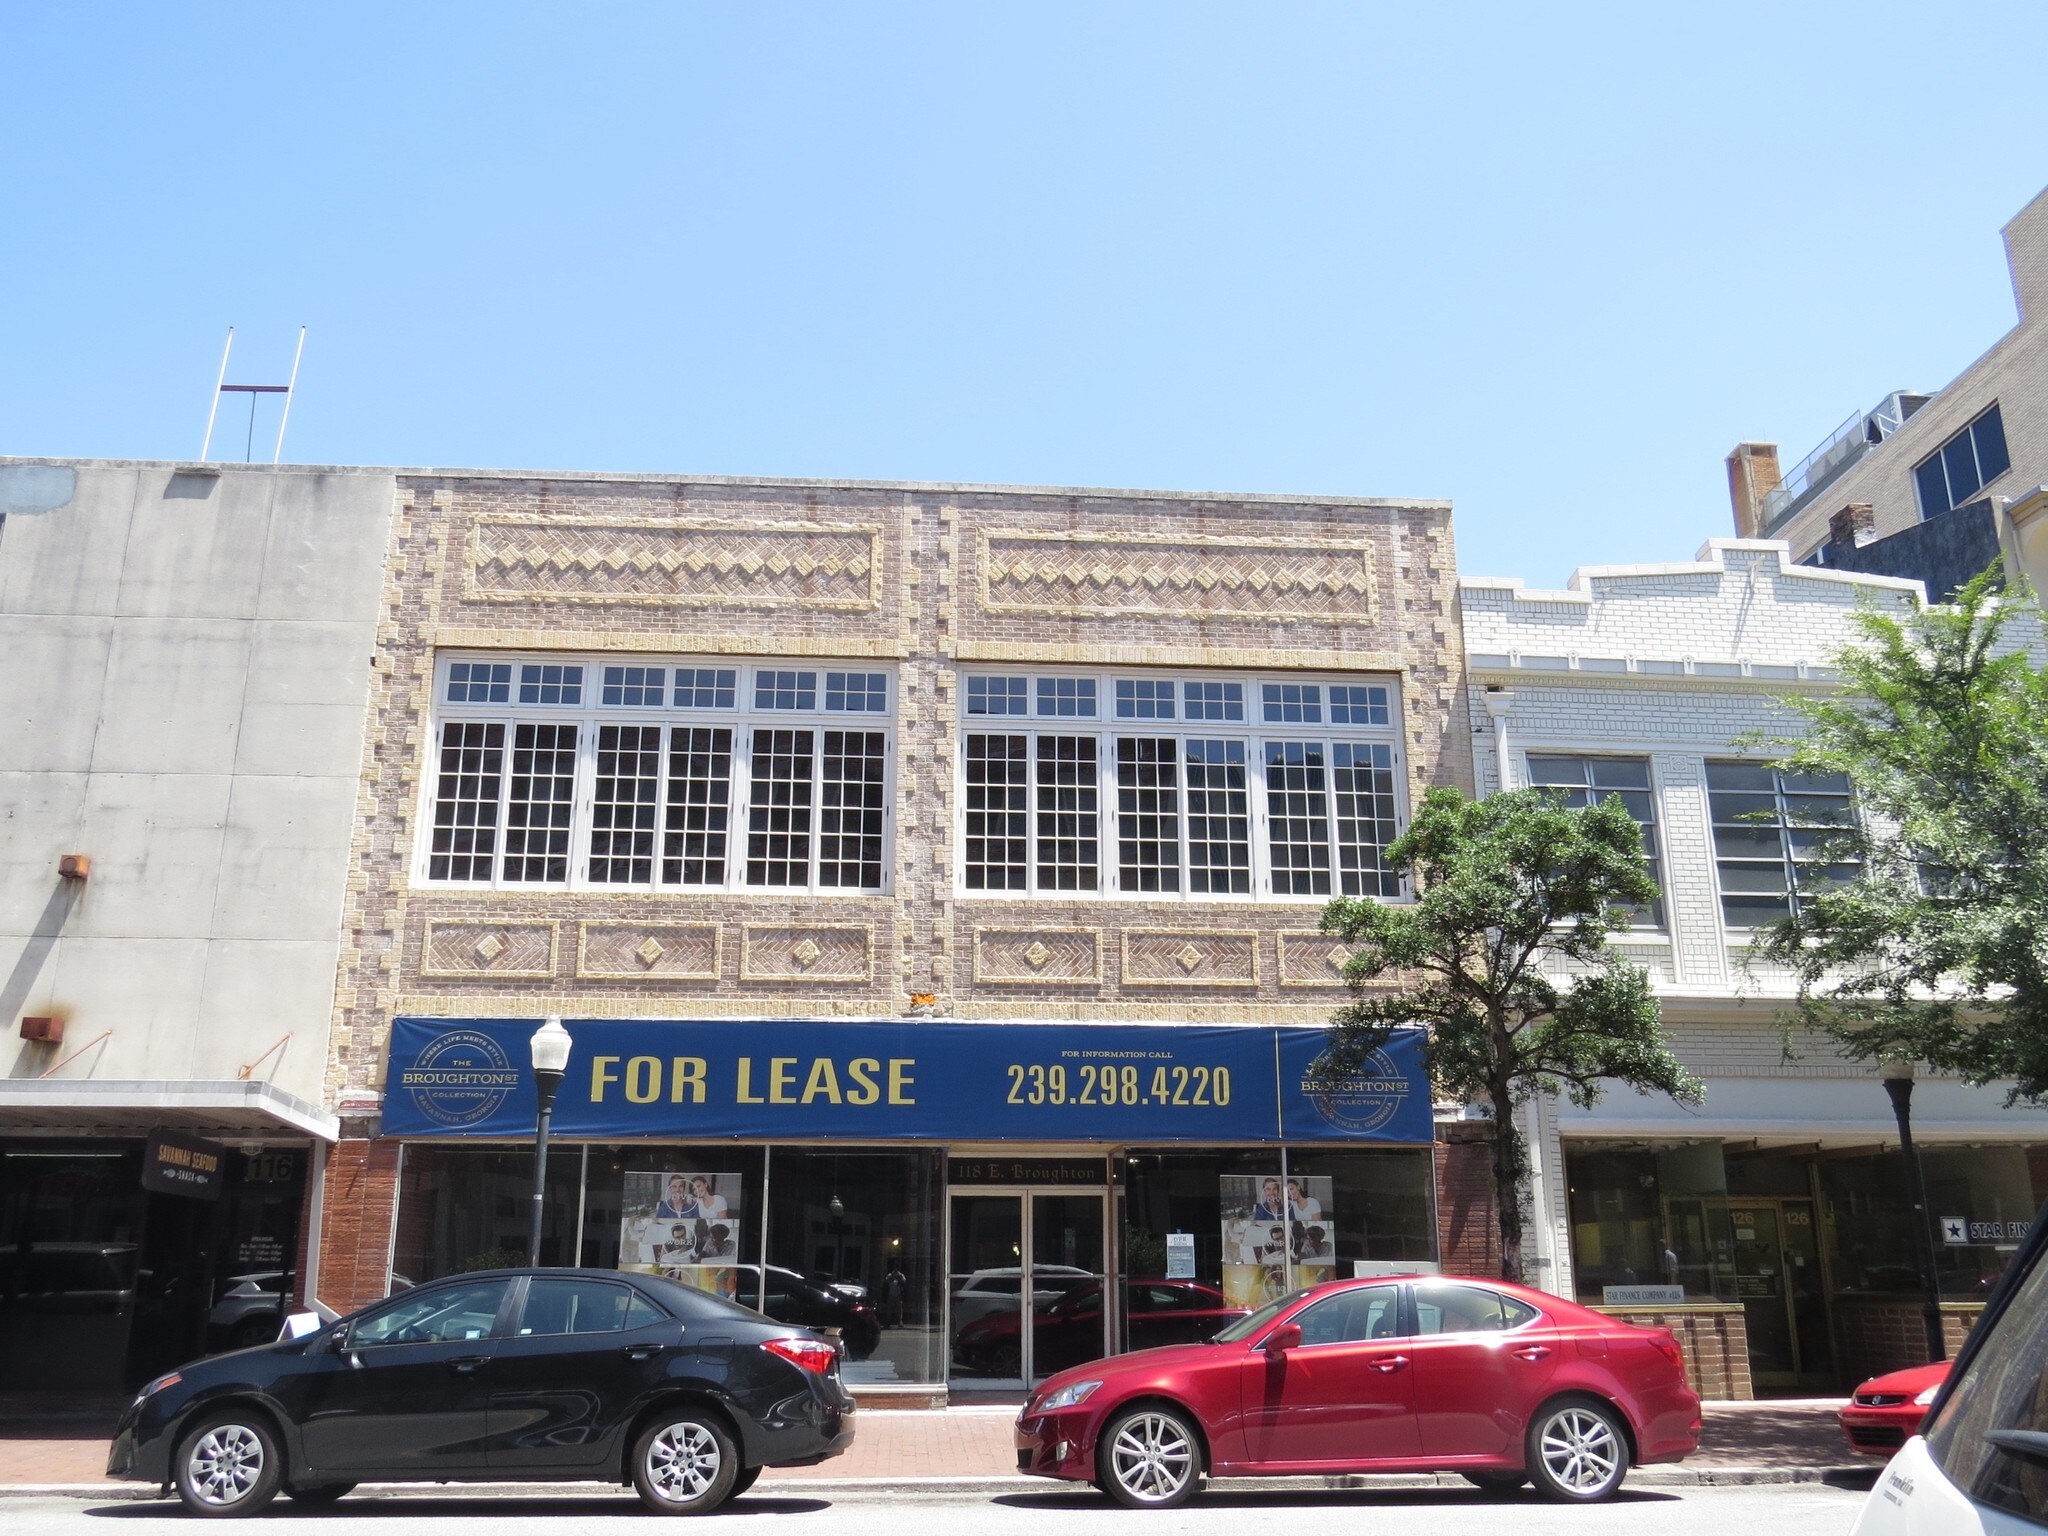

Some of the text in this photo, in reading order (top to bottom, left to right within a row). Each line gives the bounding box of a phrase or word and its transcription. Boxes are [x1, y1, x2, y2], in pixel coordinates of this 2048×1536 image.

[421, 1035, 503, 1066] WHERE LIFE MEETS STYLE
[1061, 1050, 1174, 1059] FOR INFORMATION CALL
[402, 1073, 506, 1084] BROUGHTON
[590, 1056, 916, 1105] FOR LEASE
[1007, 1064, 1230, 1106] 239.298.4220
[465, 1095, 499, 1120] GEORGIA
[1364, 1101, 1394, 1128] GEORGIA
[158, 1144, 218, 1173] SAVANNAH SEAFOOD
[252, 1156, 292, 1177] 116
[959, 1163, 1095, 1183] 118 E. Broughton
[1730, 1211, 1809, 1225] 126 126
[1970, 1222, 2032, 1239] STAR FIN
[1606, 1291, 1618, 1301] STAR
[1619, 1290, 1641, 1300] FINANCE
[1641, 1290, 1667, 1300] COMPANY
